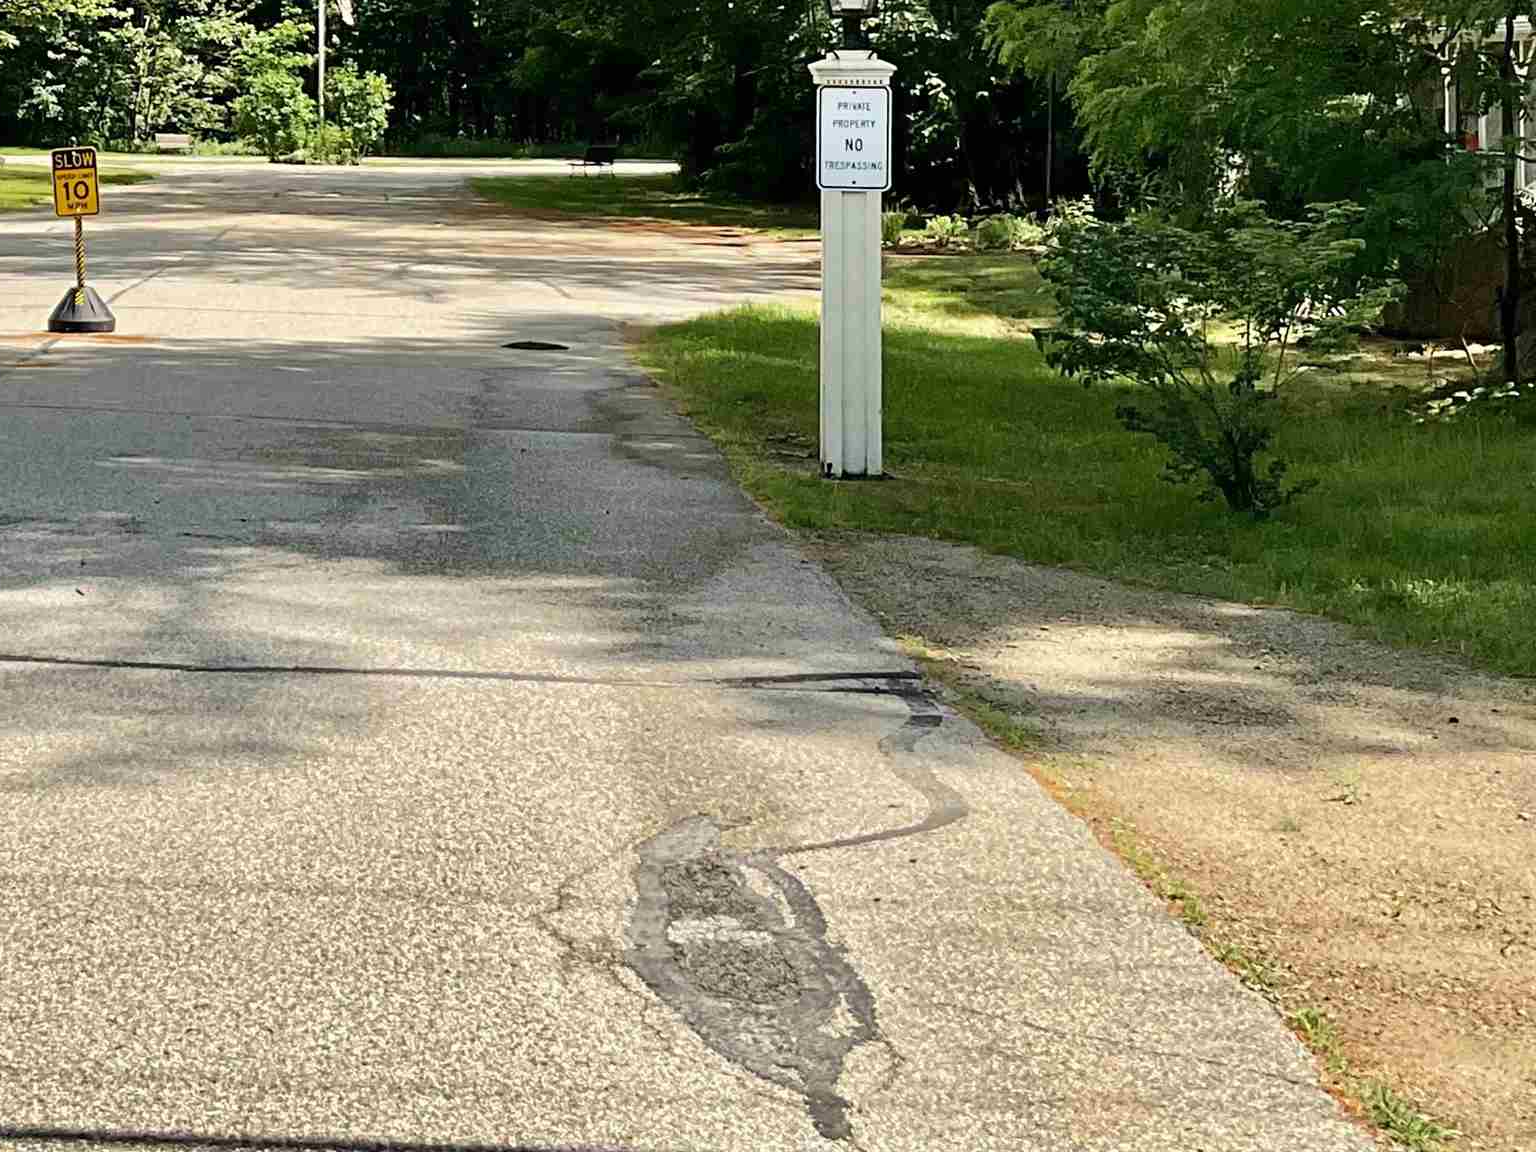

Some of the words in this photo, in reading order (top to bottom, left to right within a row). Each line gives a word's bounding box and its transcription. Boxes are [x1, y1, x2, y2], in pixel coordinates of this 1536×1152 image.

[838, 102, 871, 111] PRIVATE
[833, 120, 875, 128] PROPERTY
[845, 138, 863, 151] NO
[55, 152, 93, 168] SLOW
[825, 161, 882, 169] TRESPASSING
[63, 180, 90, 201] 10
